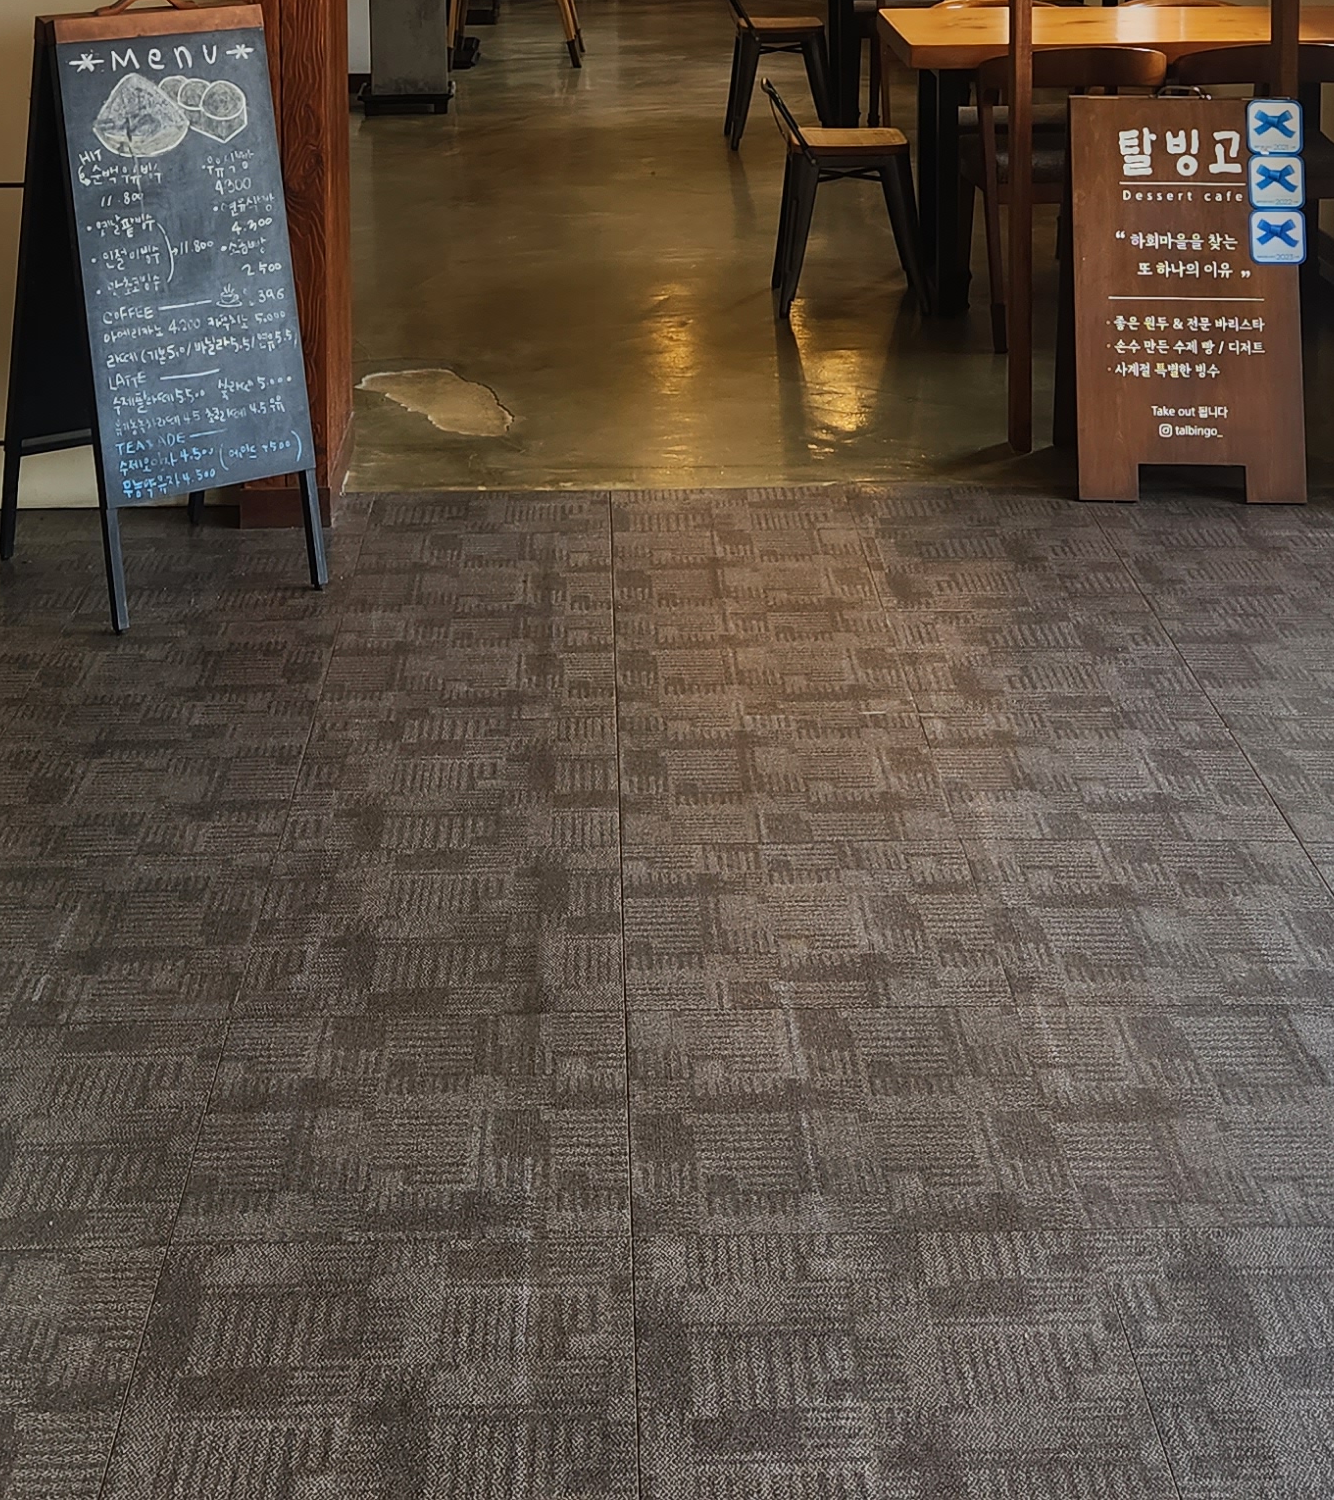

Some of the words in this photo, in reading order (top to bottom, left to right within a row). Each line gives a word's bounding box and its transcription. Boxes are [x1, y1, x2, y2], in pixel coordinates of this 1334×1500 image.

[110, 44, 217, 71] Menu
[78, 148, 101, 165] HIT
[1118, 126, 1243, 176] 탈빙고
[1121, 188, 1194, 202] Dessert
[1203, 191, 1244, 203] cafe
[1129, 232, 1205, 250] 하회마을을
[1208, 233, 1238, 251] 찾는
[1137, 262, 1153, 276] 또
[1156, 260, 1200, 278] 하나의
[1203, 260, 1234, 279] 이유
[102, 305, 154, 325] COFFEE
[1113, 315, 1140, 331] 좋은
[1143, 315, 1169, 331] 원두
[1172, 318, 1184, 330] &
[1186, 316, 1212, 332] 전문
[1214, 317, 1265, 333] 바리스타
[1114, 338, 1141, 354] 손수
[1143, 338, 1170, 354] 만든
[1172, 339, 1199, 355] 수제
[1201, 339, 1215, 355] 빵
[1228, 340, 1266, 355] 디저트
[1114, 361, 1151, 378] 사계절
[1195, 362, 1221, 378] 빙수
[1151, 405, 1175, 417] Take
[1177, 406, 1196, 417] out
[1198, 405, 1228, 419] 됩니다
